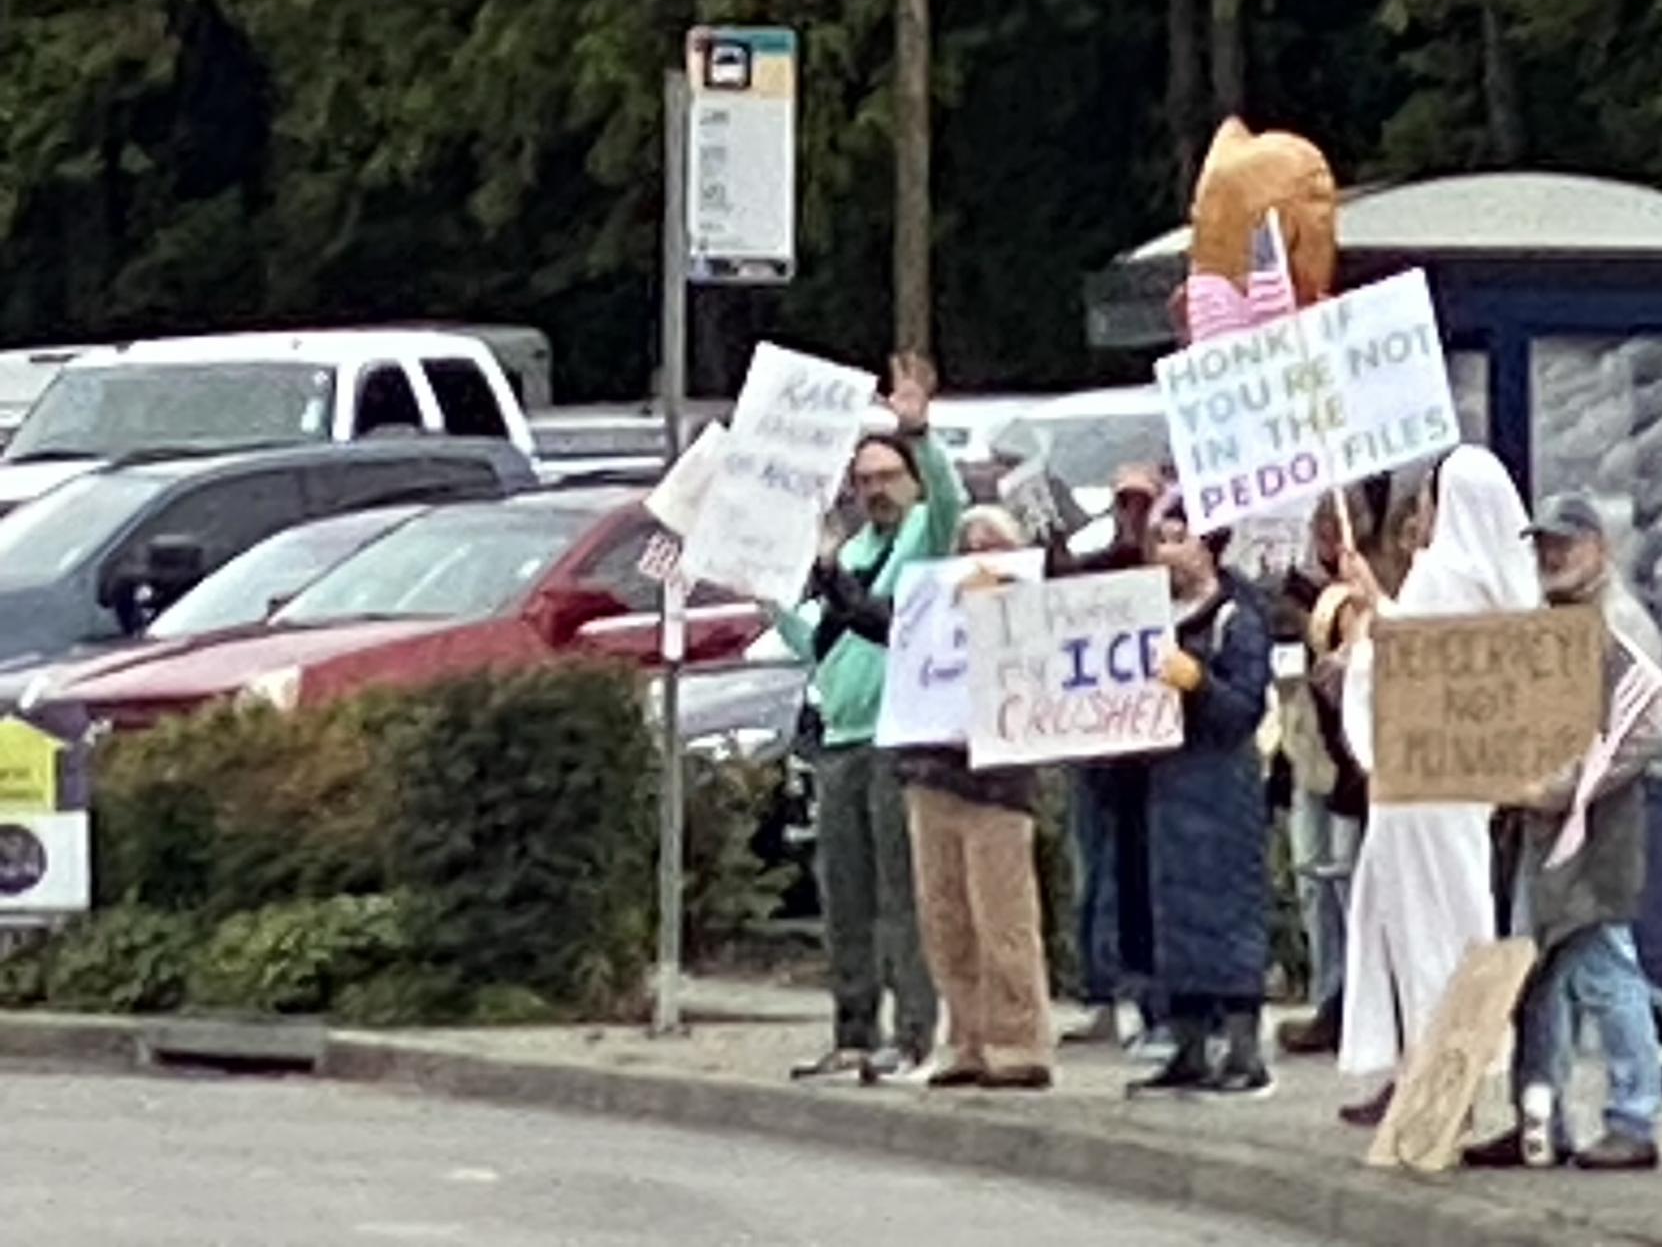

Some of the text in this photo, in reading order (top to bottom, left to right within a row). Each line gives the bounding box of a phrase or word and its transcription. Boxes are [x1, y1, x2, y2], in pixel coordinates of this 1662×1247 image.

[1168, 302, 1351, 393] HONK IF
[1178, 323, 1431, 432] YOURE NOT
[1190, 395, 1345, 475] IN THE
[1200, 405, 1448, 519] PEDO FILES
[1061, 627, 1165, 691] ICE
